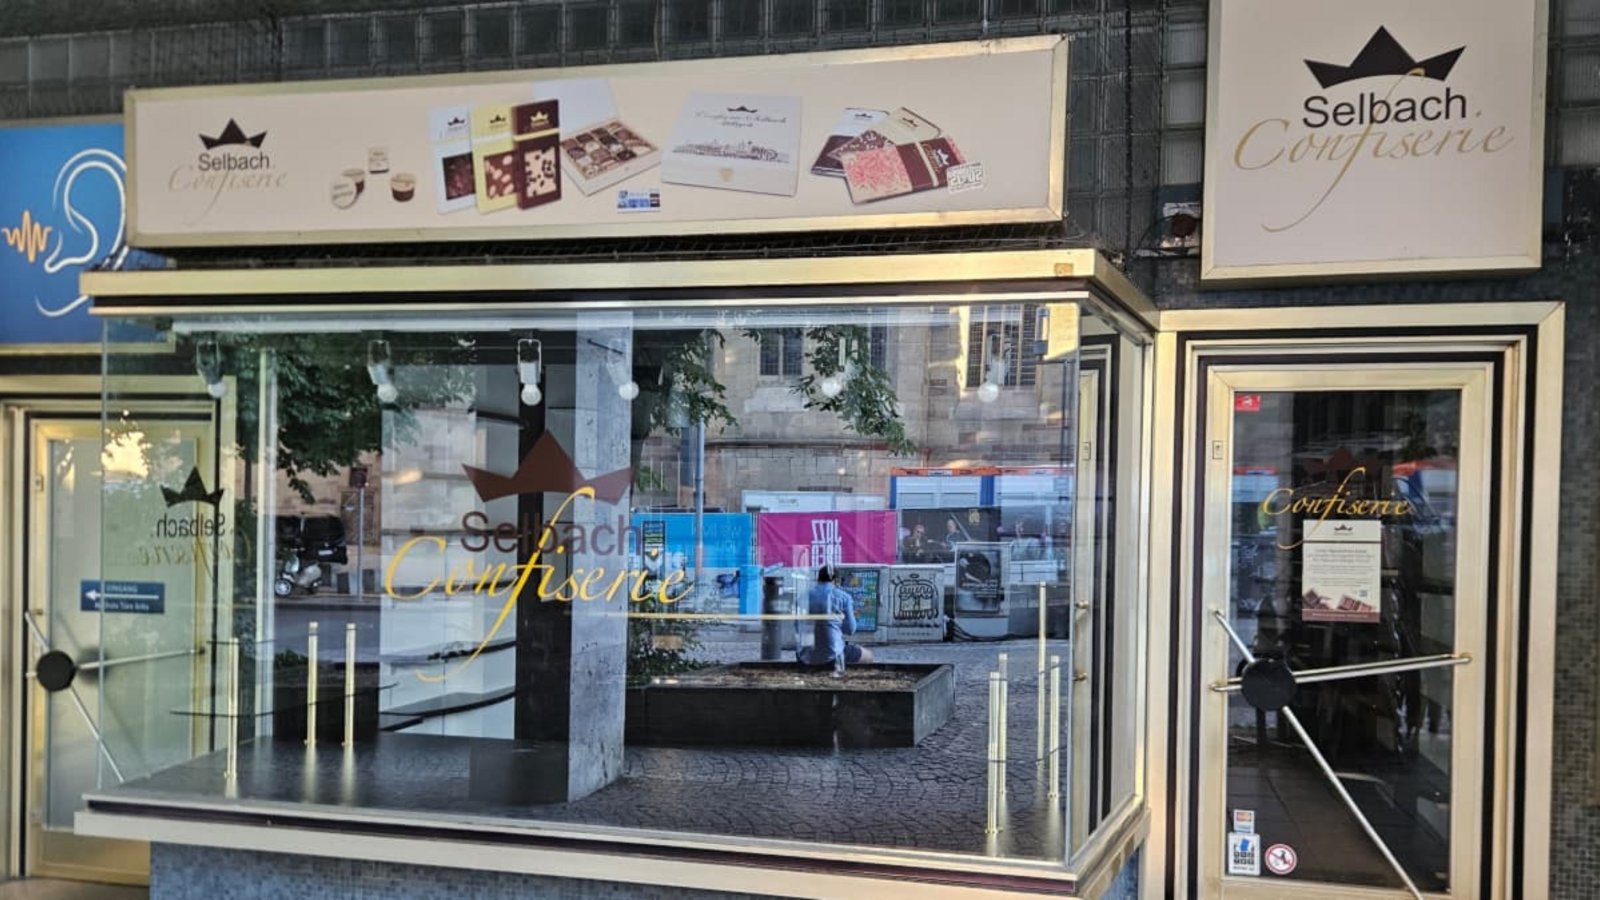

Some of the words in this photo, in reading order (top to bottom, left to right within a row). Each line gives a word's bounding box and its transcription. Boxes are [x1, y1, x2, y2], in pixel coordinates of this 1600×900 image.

[1302, 87, 1467, 128] Selbach
[197, 151, 270, 172] Selbach
[460, 511, 641, 556] Selbach
[384, 486, 695, 682] Confiserie
